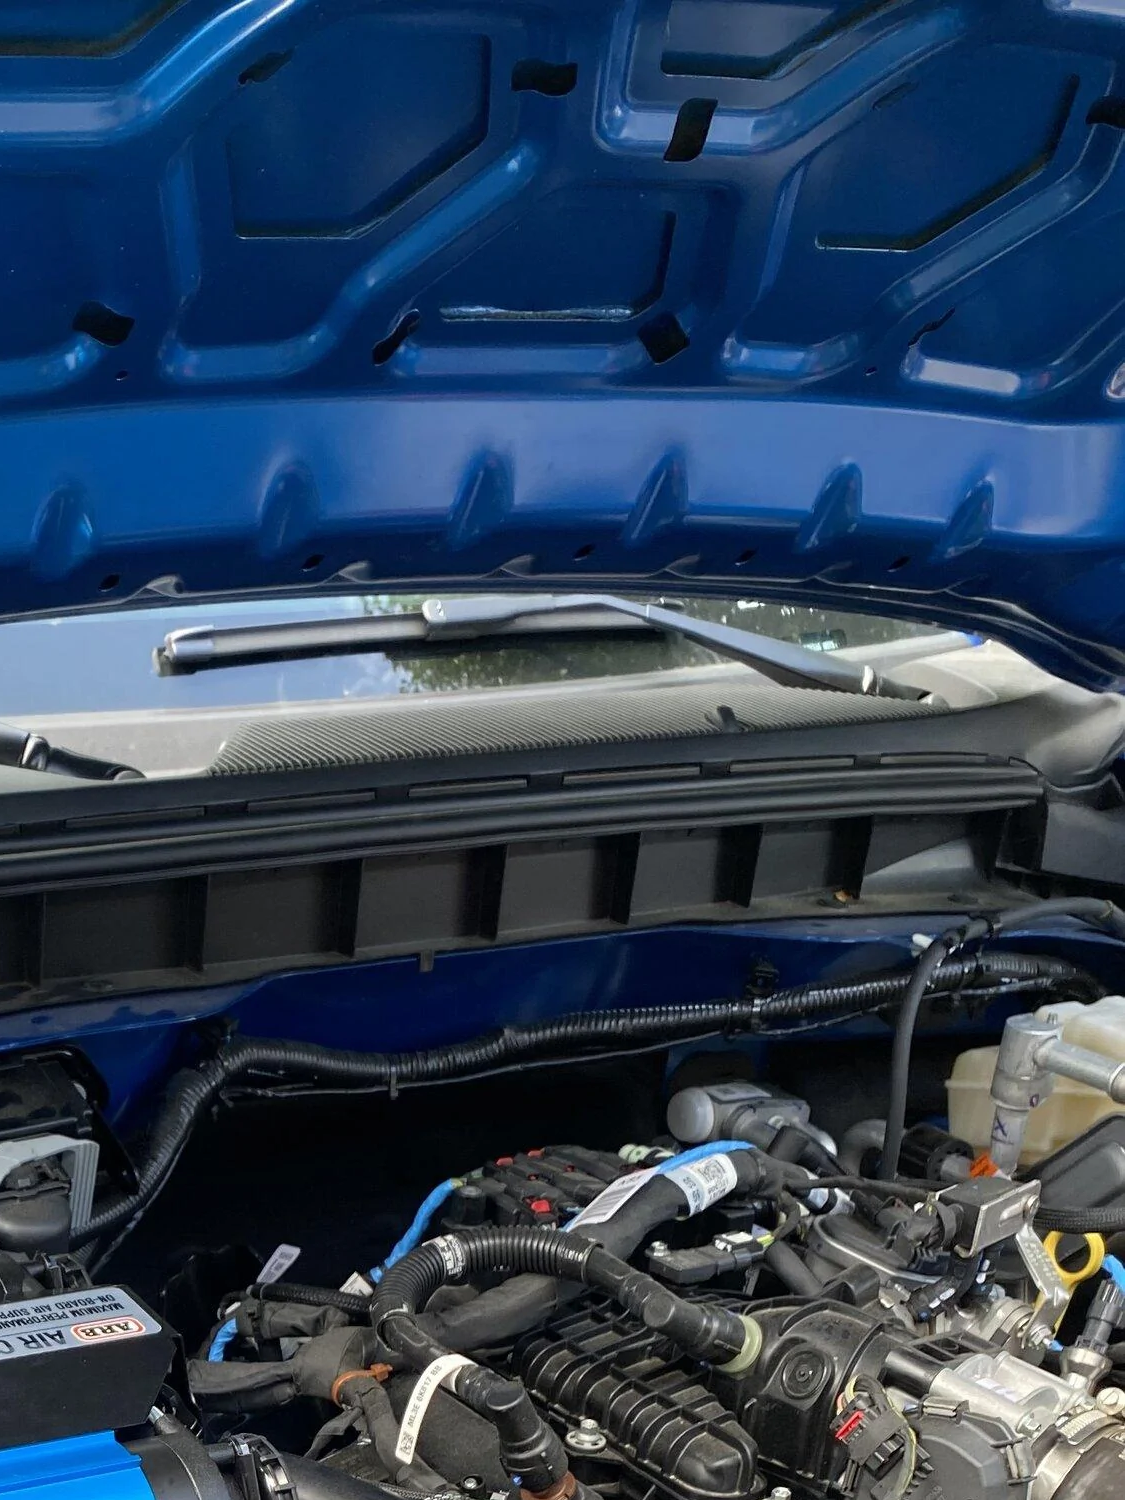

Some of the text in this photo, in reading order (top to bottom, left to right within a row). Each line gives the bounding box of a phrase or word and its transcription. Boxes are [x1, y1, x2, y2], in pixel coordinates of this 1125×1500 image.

[30, 1305, 52, 1314] AIR
[54, 1294, 116, 1310] ON-BOARD
[70, 1302, 125, 1317] MAXIMUM
[81, 1320, 131, 1337] ARB
[17, 1329, 67, 1350] AIR
